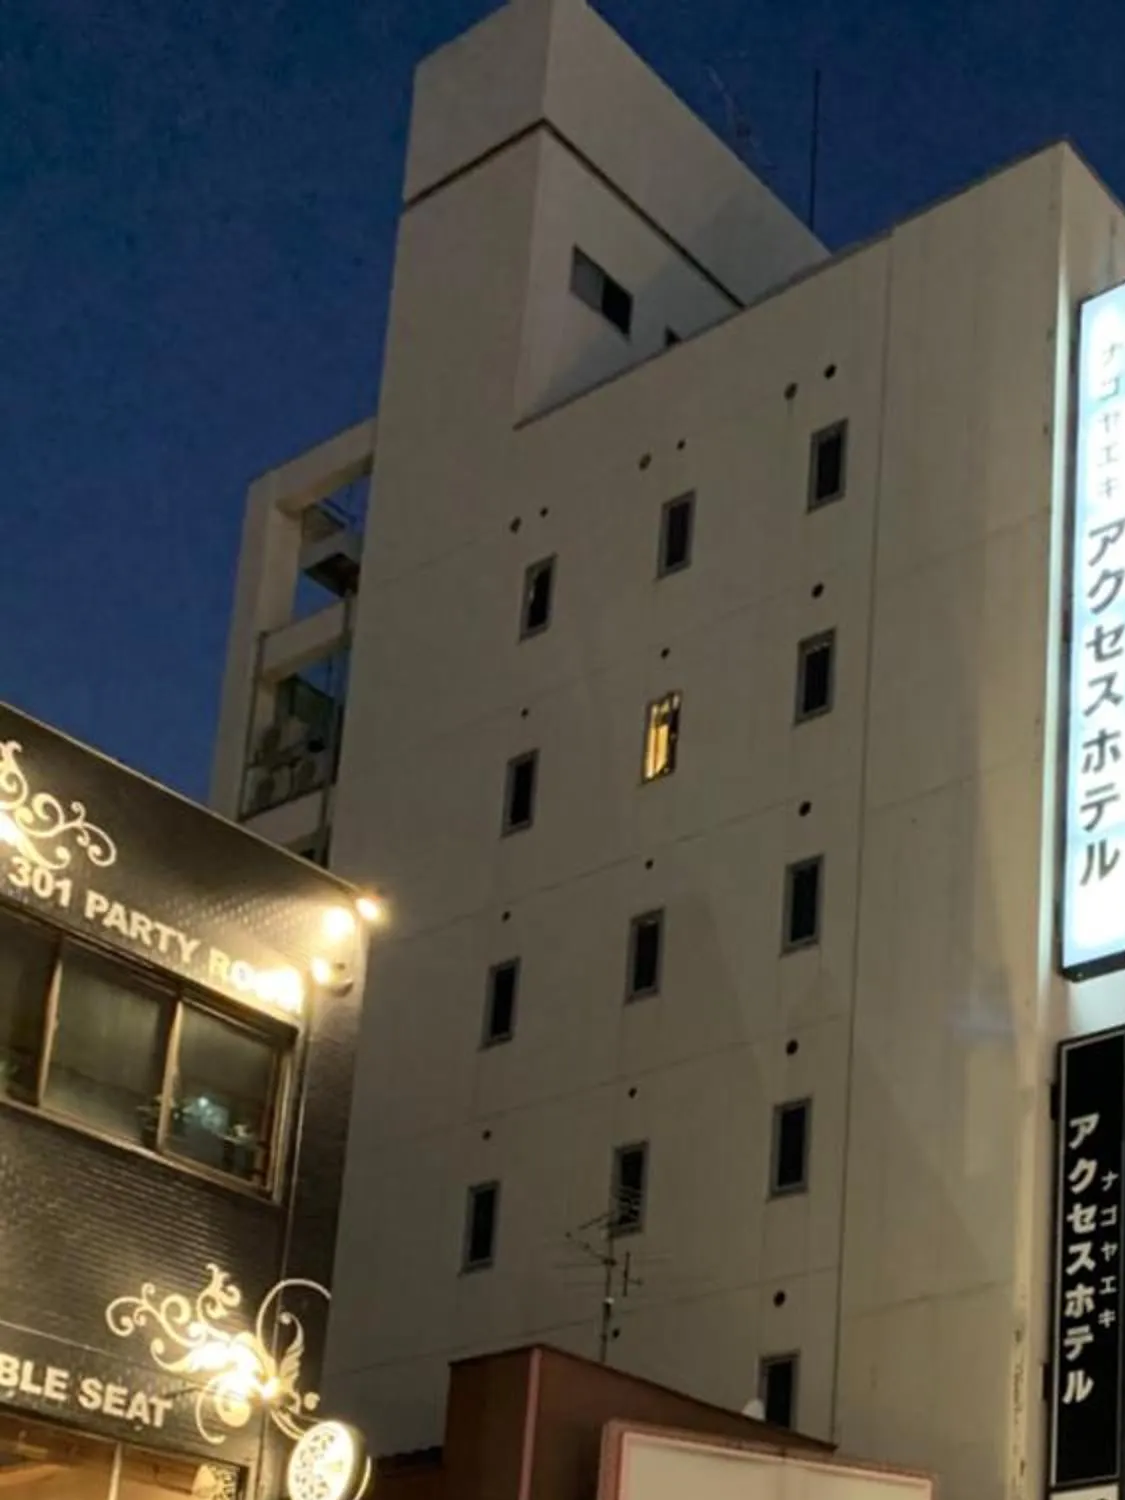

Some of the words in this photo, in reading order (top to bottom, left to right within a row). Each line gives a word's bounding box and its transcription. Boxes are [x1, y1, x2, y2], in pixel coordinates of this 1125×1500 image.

[8, 855, 72, 907] 301
[84, 889, 200, 963] PARTY
[208, 947, 303, 1010] RO
[1062, 1112, 1099, 1404] アクセスホテル
[1098, 1169, 1119, 1328] ナゴヤエキ
[78, 1377, 172, 1428] SEAT
